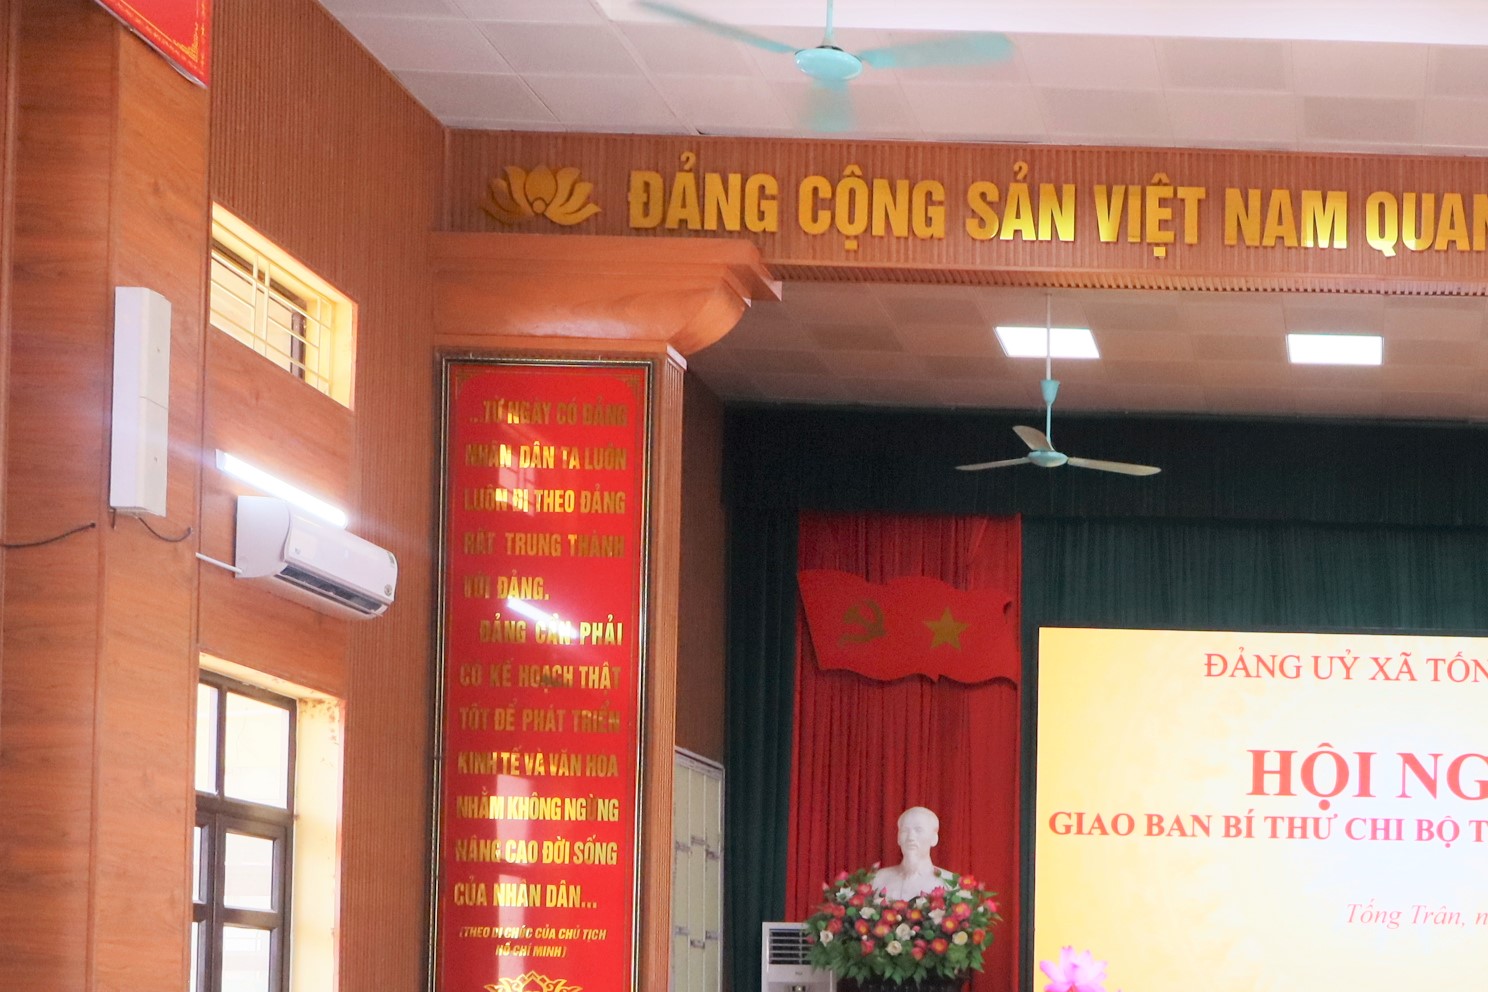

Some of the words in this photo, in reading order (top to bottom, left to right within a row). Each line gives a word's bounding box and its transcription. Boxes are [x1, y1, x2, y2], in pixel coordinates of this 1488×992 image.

[628, 152, 779, 233] ĐẢNG
[798, 165, 945, 251] CỘNG
[966, 162, 1076, 242] SẢN
[1093, 173, 1206, 258] VIỆT
[1224, 188, 1348, 250] NAM
[519, 441, 554, 468] DÂN
[561, 446, 580, 469] TA
[535, 490, 575, 512] THEO
[580, 483, 626, 514] ĐẢNG
[505, 532, 561, 556] TRUNG
[480, 613, 526, 643] ĐẢNG
[580, 614, 622, 645] PHẢI
[519, 665, 573, 693] HOẠCH
[579, 661, 620, 695] THẬT
[1204, 647, 1303, 680] ĐẢNG
[1311, 649, 1360, 681] UỶ
[1369, 652, 1418, 682] XÃ
[494, 698, 517, 731] ĐỂ
[522, 704, 565, 732] PHÁT
[458, 751, 497, 774] KINH
[501, 745, 521, 775] TẾ
[524, 747, 545, 775] VÀ
[550, 749, 581, 776] VĂN
[1246, 742, 1377, 811] HỘI
[456, 786, 504, 820] NHẰM
[508, 792, 561, 820] KHÔNG
[564, 794, 619, 821] NGỪNG
[1048, 812, 1135, 836] GIAO
[1144, 813, 1212, 838] BAN
[1221, 808, 1256, 839] BÍ
[1264, 813, 1338, 840] THƯ
[1345, 817, 1405, 841] CHI
[1415, 815, 1460, 848] BỘ
[456, 835, 501, 862] NÂNG
[505, 839, 538, 863] CAO
[542, 836, 570, 864] ĐỜI
[574, 835, 618, 865] SỐNG
[454, 876, 487, 906] CỦA
[493, 879, 541, 907] NHÂN
[546, 880, 598, 908] DÂN...
[1347, 899, 1402, 930] Tống
[1411, 904, 1465, 928] Trân,
[535, 924, 556, 939] CỦA
[558, 925, 580, 939] CHỦ
[583, 929, 606, 942] TỊCH
